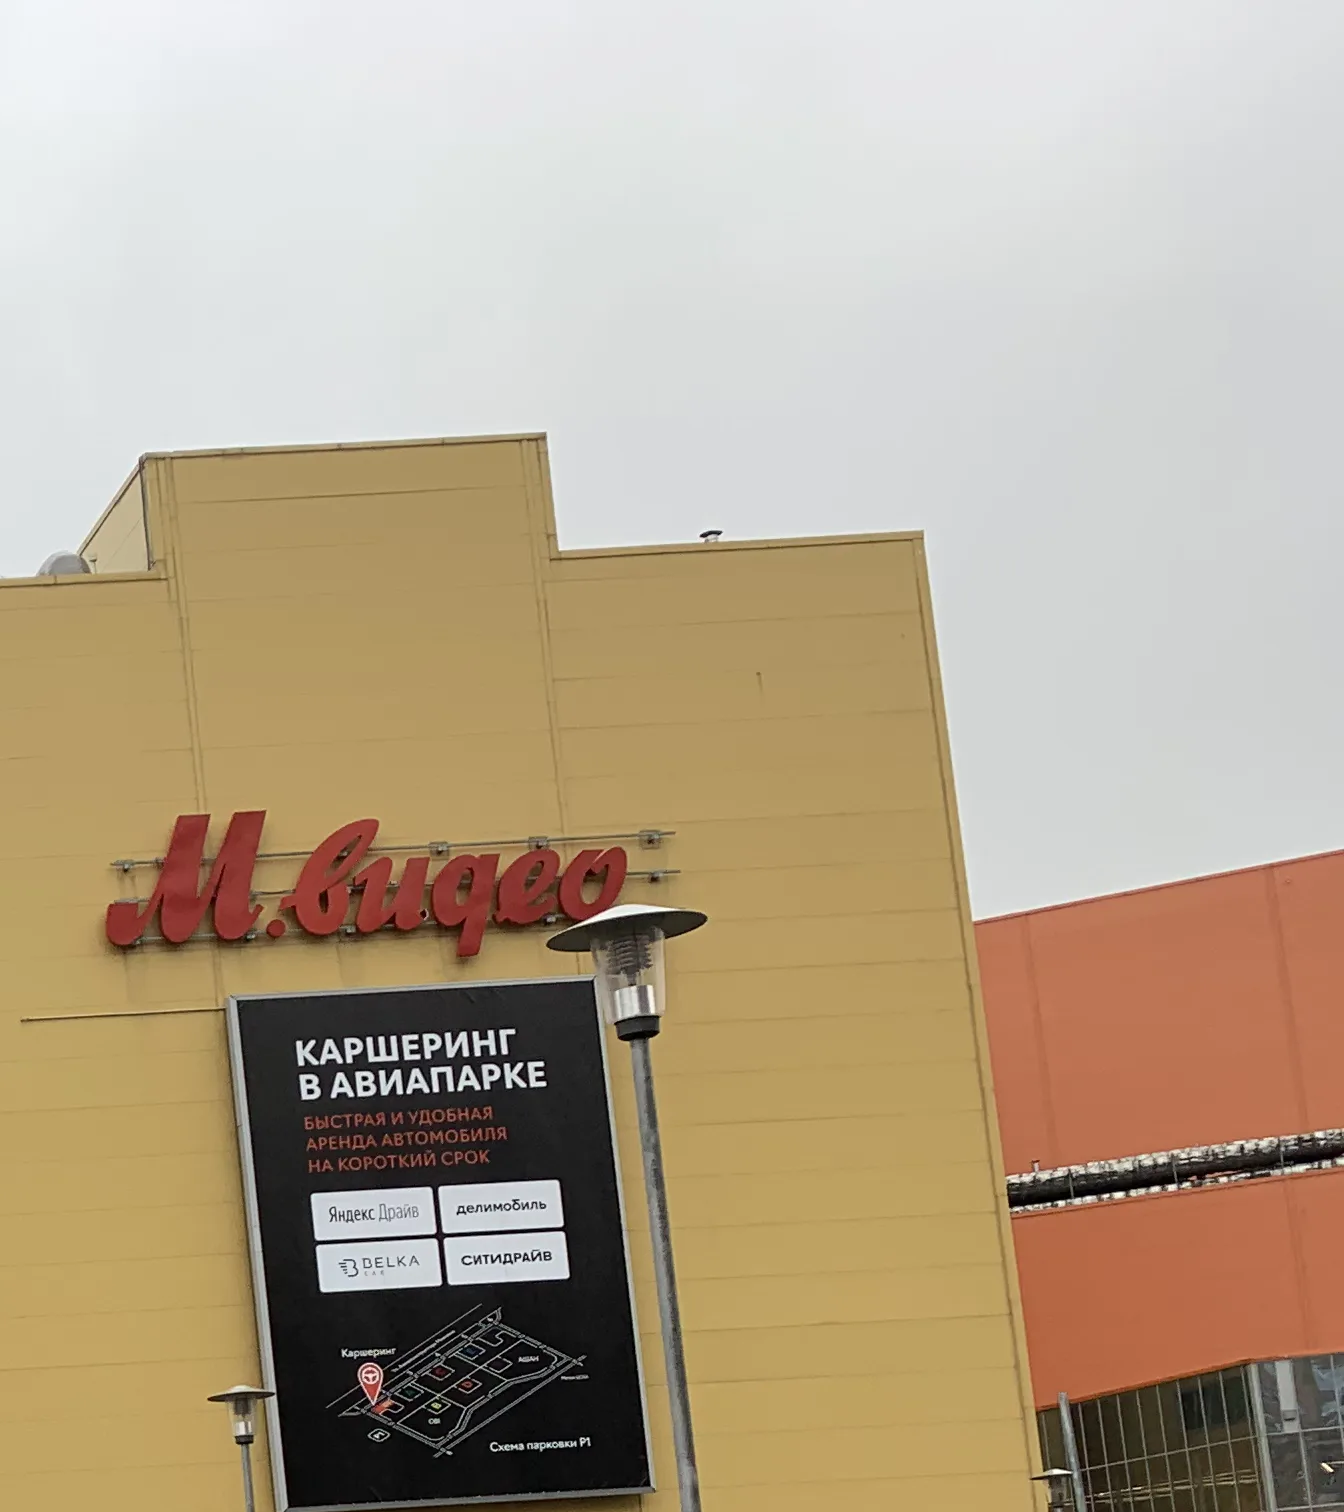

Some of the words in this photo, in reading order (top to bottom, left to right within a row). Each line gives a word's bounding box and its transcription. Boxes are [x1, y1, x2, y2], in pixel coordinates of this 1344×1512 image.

[295, 1028, 516, 1066] КАРШЕРИНГ
[299, 1074, 321, 1100] В
[330, 1061, 547, 1099] АВИАПАРКЕ
[304, 1112, 386, 1131] БЫСТРАЯ
[391, 1111, 405, 1125] И
[408, 1105, 493, 1127] УДОБНАЯ
[305, 1132, 377, 1151] АРЕНДА
[381, 1126, 508, 1147] АВТОМОБИЛЯ
[308, 1158, 333, 1173] НА
[338, 1150, 437, 1171] КОРОТКИЙ
[441, 1149, 490, 1167] СРОК
[329, 1206, 376, 1224] Яндекс
[378, 1202, 420, 1222] Драйв
[456, 1198, 547, 1216] делимобиль
[362, 1255, 420, 1269] BELKA
[461, 1249, 553, 1266] СИТИДРАЙВ
[341, 1346, 397, 1359] Каршеринг
[489, 1442, 525, 1452] Схема
[527, 1440, 577, 1452] парковки
